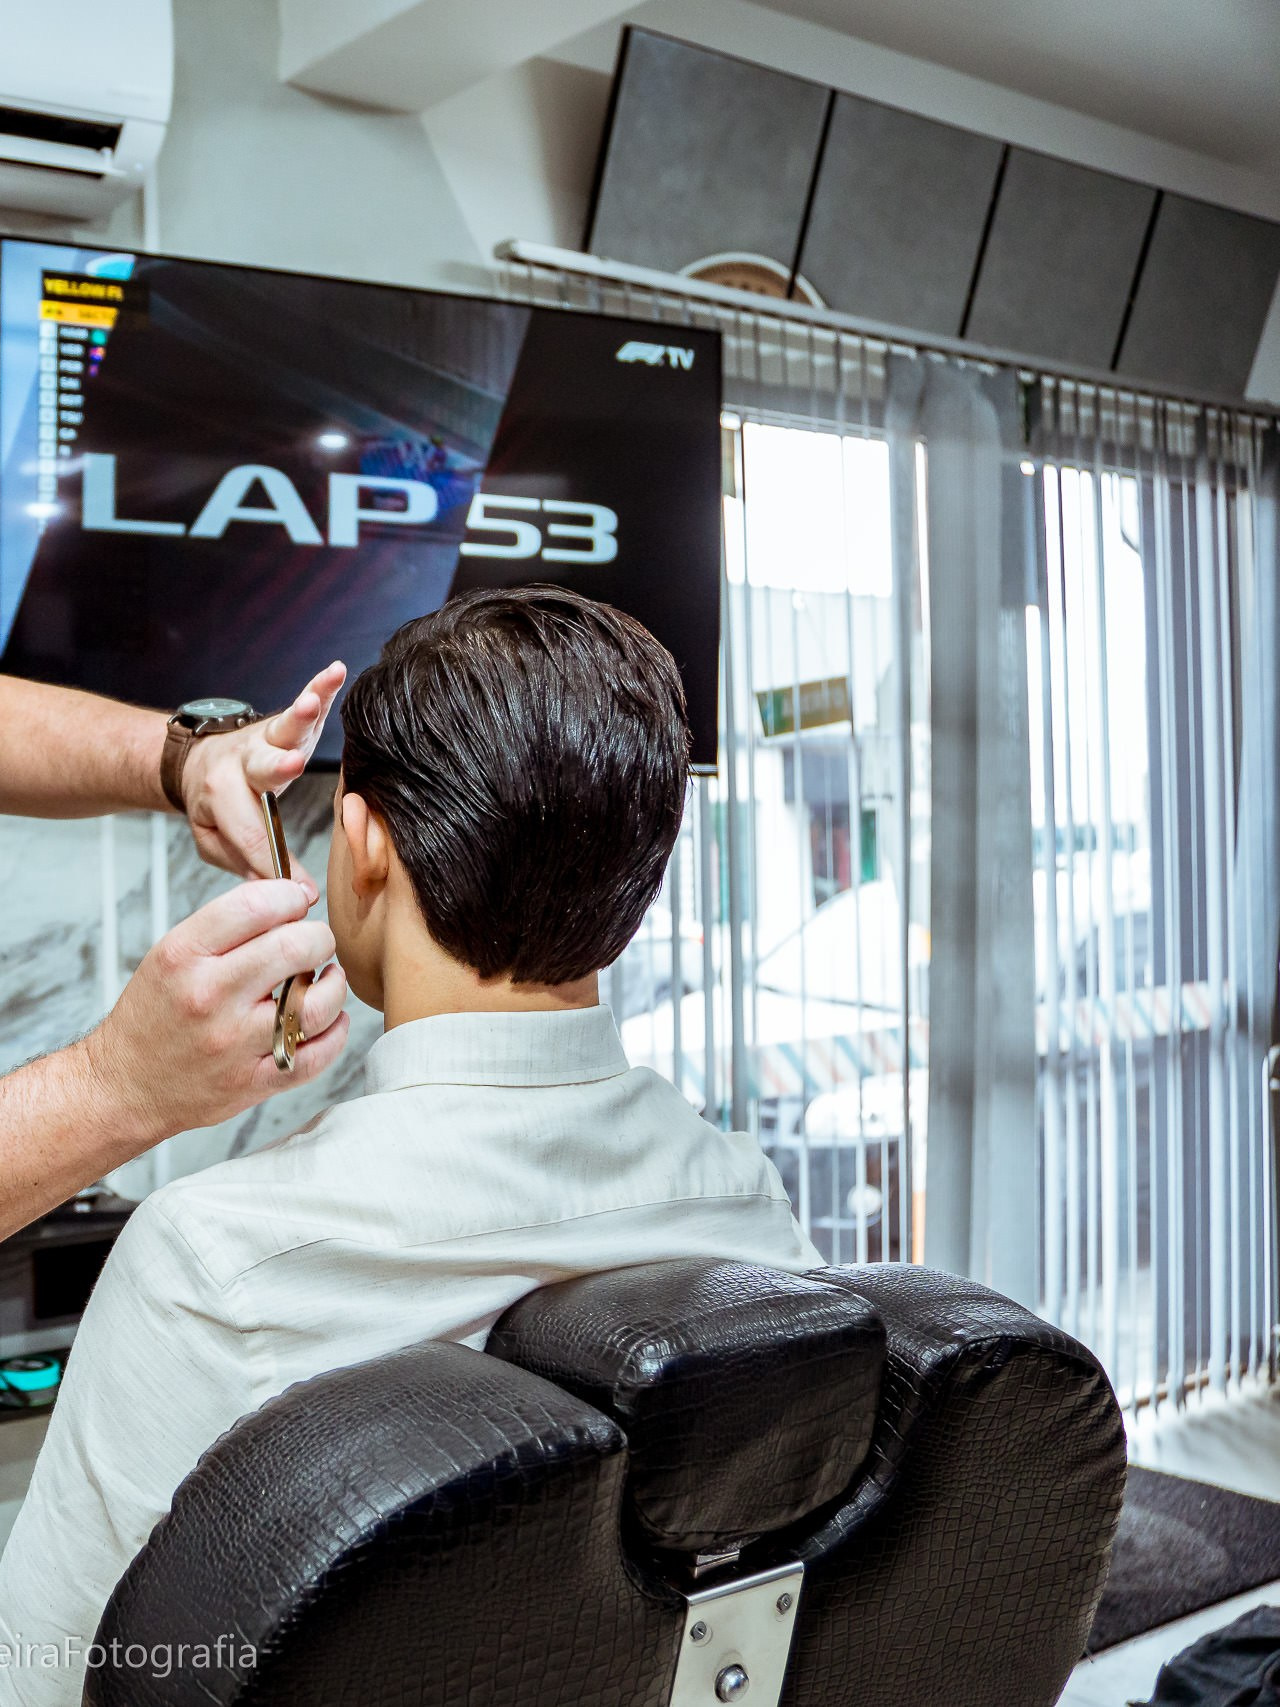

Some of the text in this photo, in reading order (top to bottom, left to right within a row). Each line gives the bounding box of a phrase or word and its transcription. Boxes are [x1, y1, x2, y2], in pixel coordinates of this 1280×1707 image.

[43, 278, 105, 299] YELLOW
[666, 345, 695, 371] TV
[82, 452, 618, 564] LAP 53
